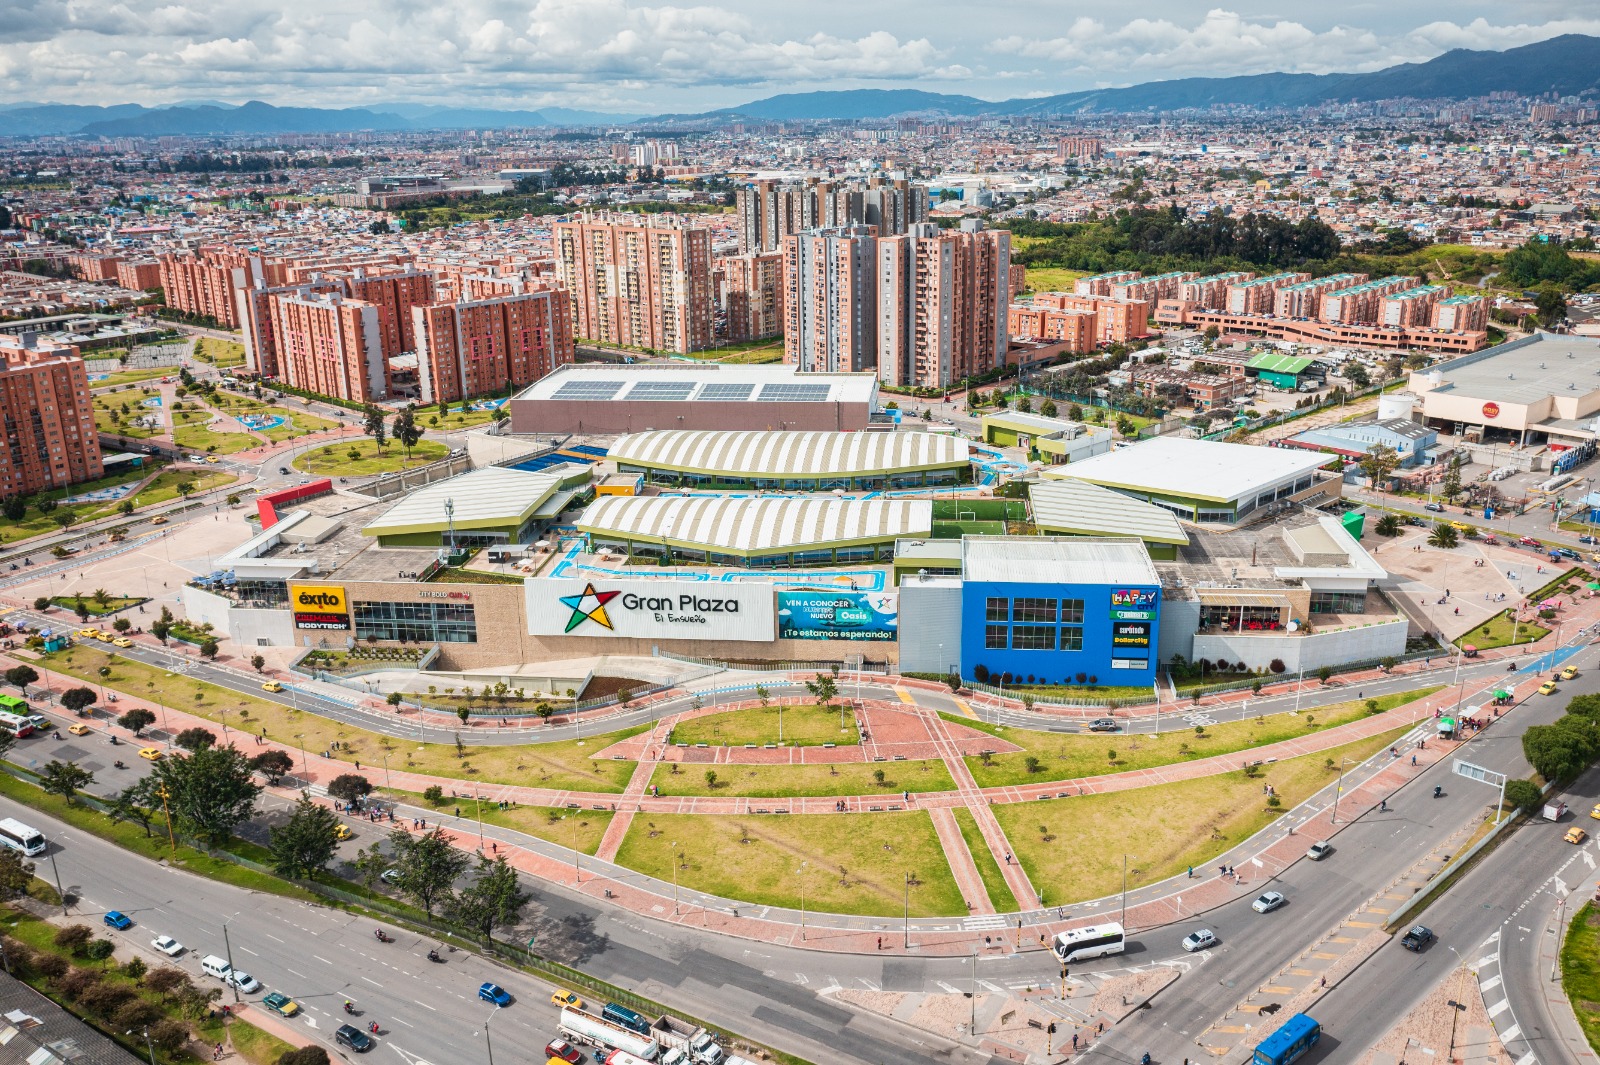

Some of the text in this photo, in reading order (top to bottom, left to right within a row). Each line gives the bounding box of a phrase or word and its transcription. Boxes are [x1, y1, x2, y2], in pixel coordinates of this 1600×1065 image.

[298, 592, 340, 609] éxito
[1114, 591, 1156, 602] HAPPY
[622, 593, 739, 612] Gran Plaza
[809, 600, 849, 608] CONOCER
[296, 614, 339, 622] CINEMARK
[654, 613, 706, 624] El Ensueño
[841, 611, 867, 620] Oasis
[784, 629, 892, 639] ¡Te estamos esperando!
